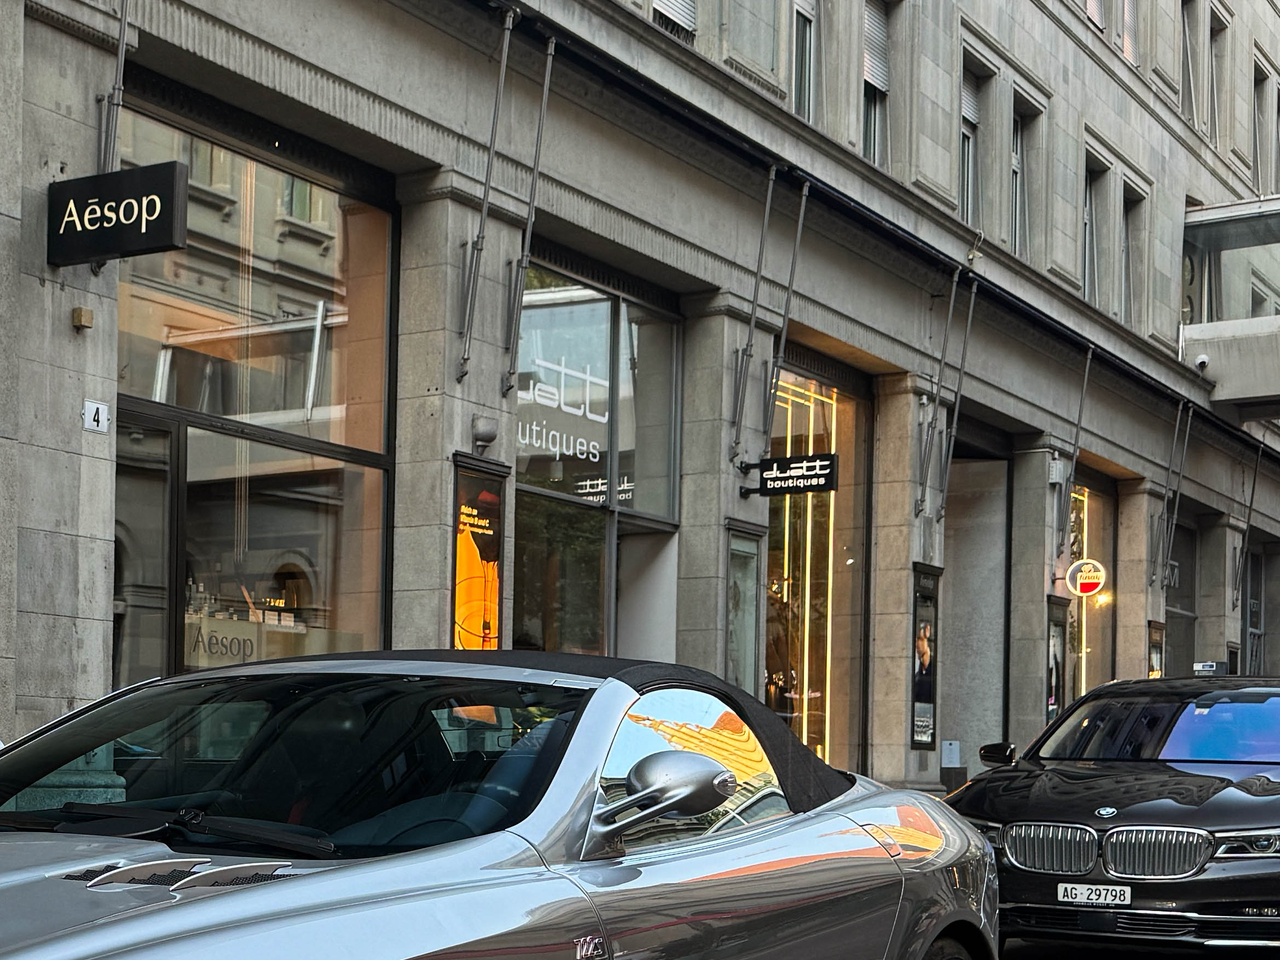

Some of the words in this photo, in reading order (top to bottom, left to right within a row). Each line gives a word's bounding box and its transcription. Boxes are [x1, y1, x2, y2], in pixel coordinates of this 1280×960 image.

[59, 194, 161, 234] Aēsop
[93, 406, 101, 427] 4
[518, 420, 600, 462] utiques
[766, 477, 826, 489] boutiques
